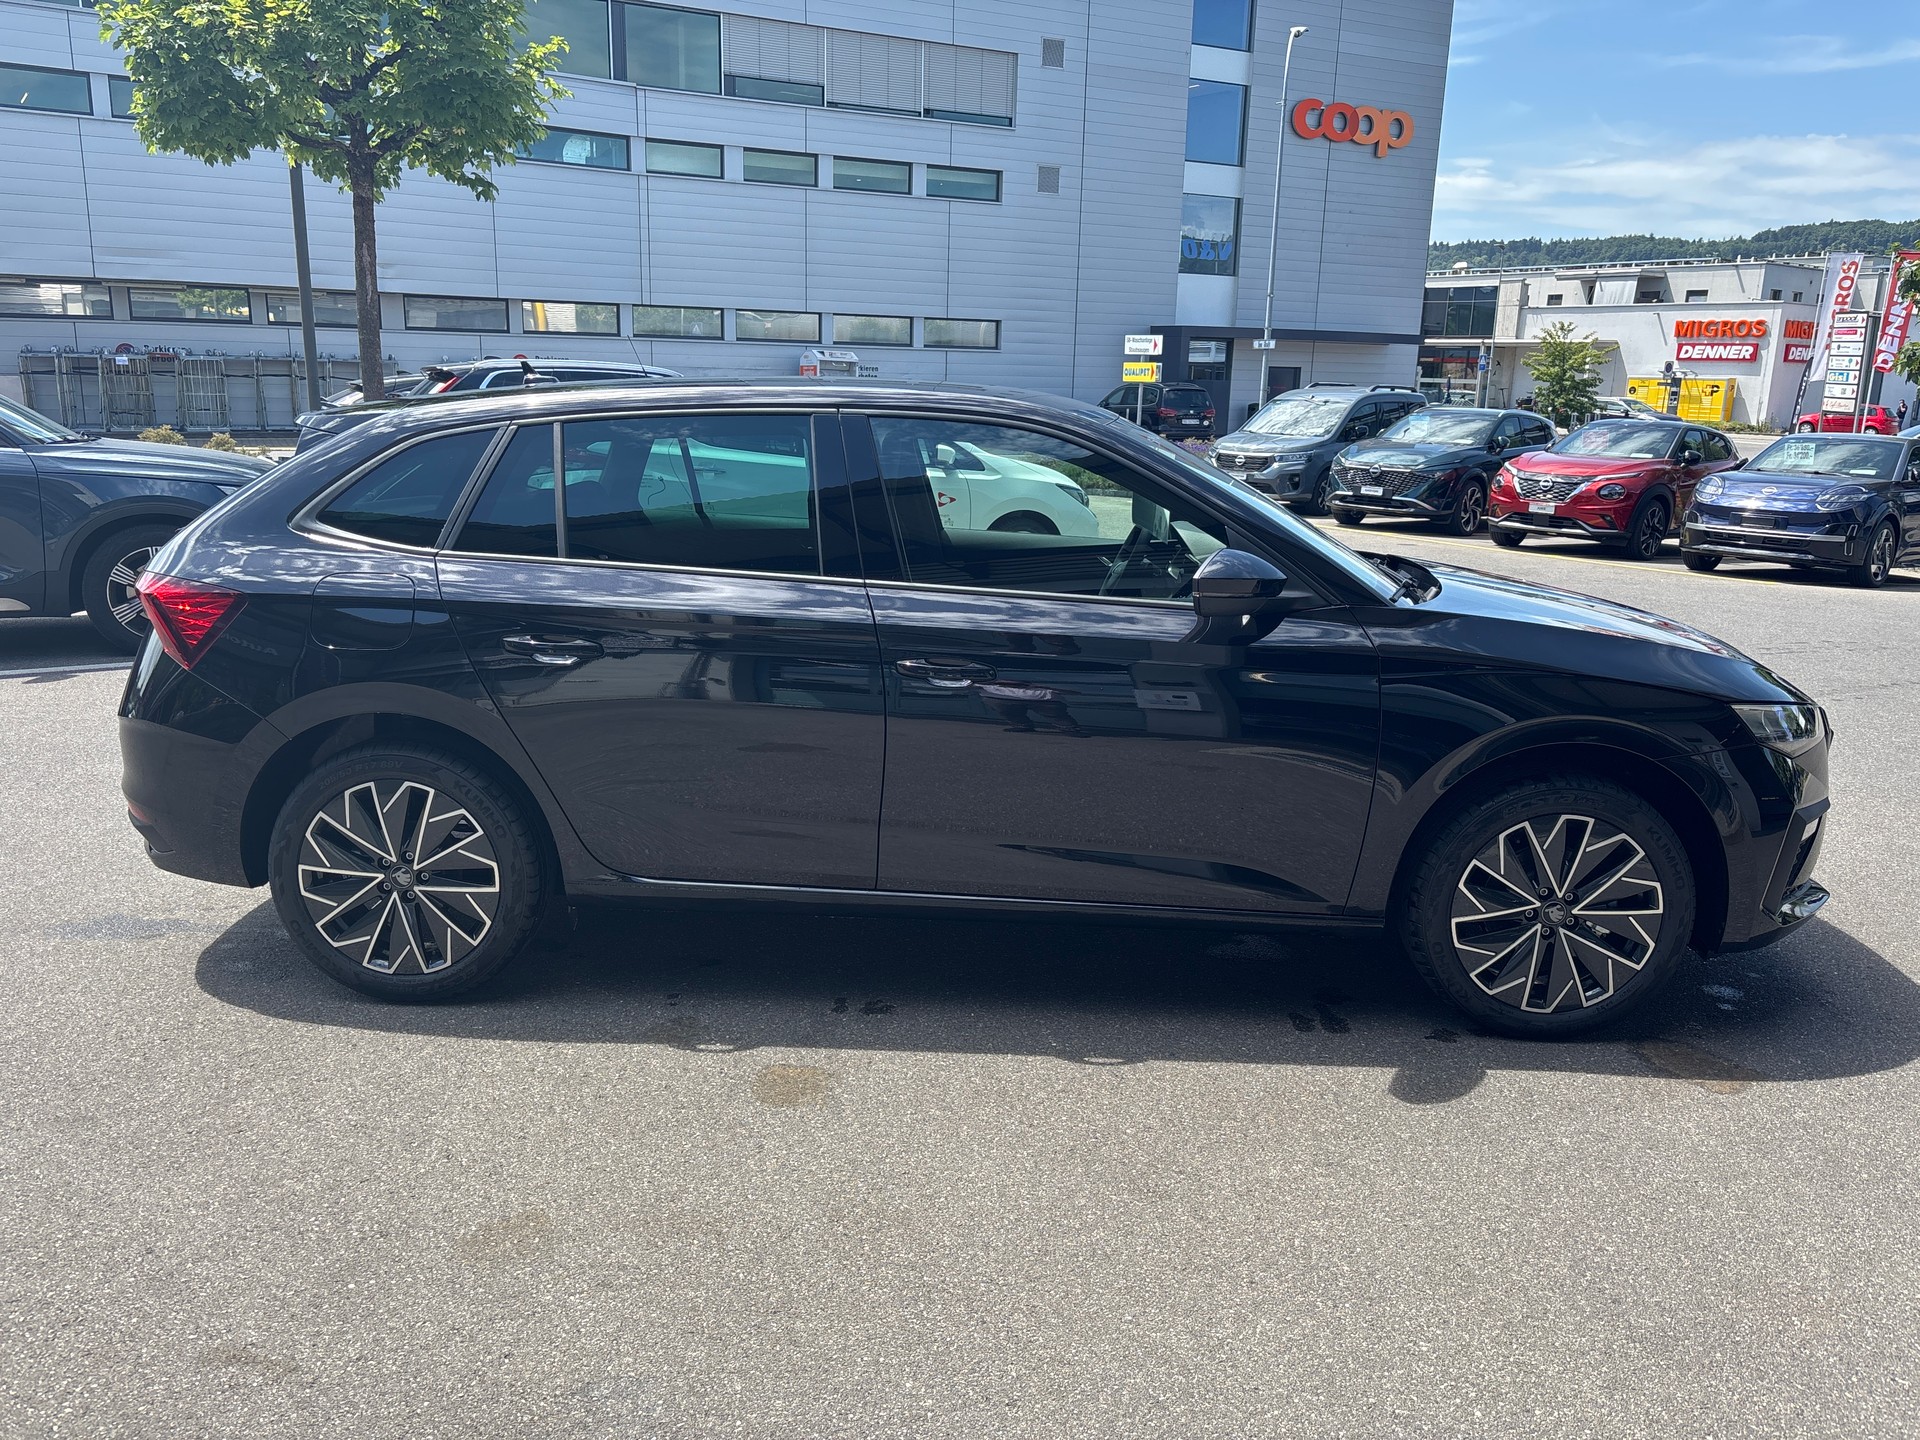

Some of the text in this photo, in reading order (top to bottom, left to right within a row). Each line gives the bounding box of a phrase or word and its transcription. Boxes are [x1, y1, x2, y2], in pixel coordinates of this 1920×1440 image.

[1292, 98, 1414, 157] coop
[1674, 319, 1767, 338] MIGROS
[1678, 345, 1754, 359] DENNER
[1124, 367, 1150, 377] QUALIPET
